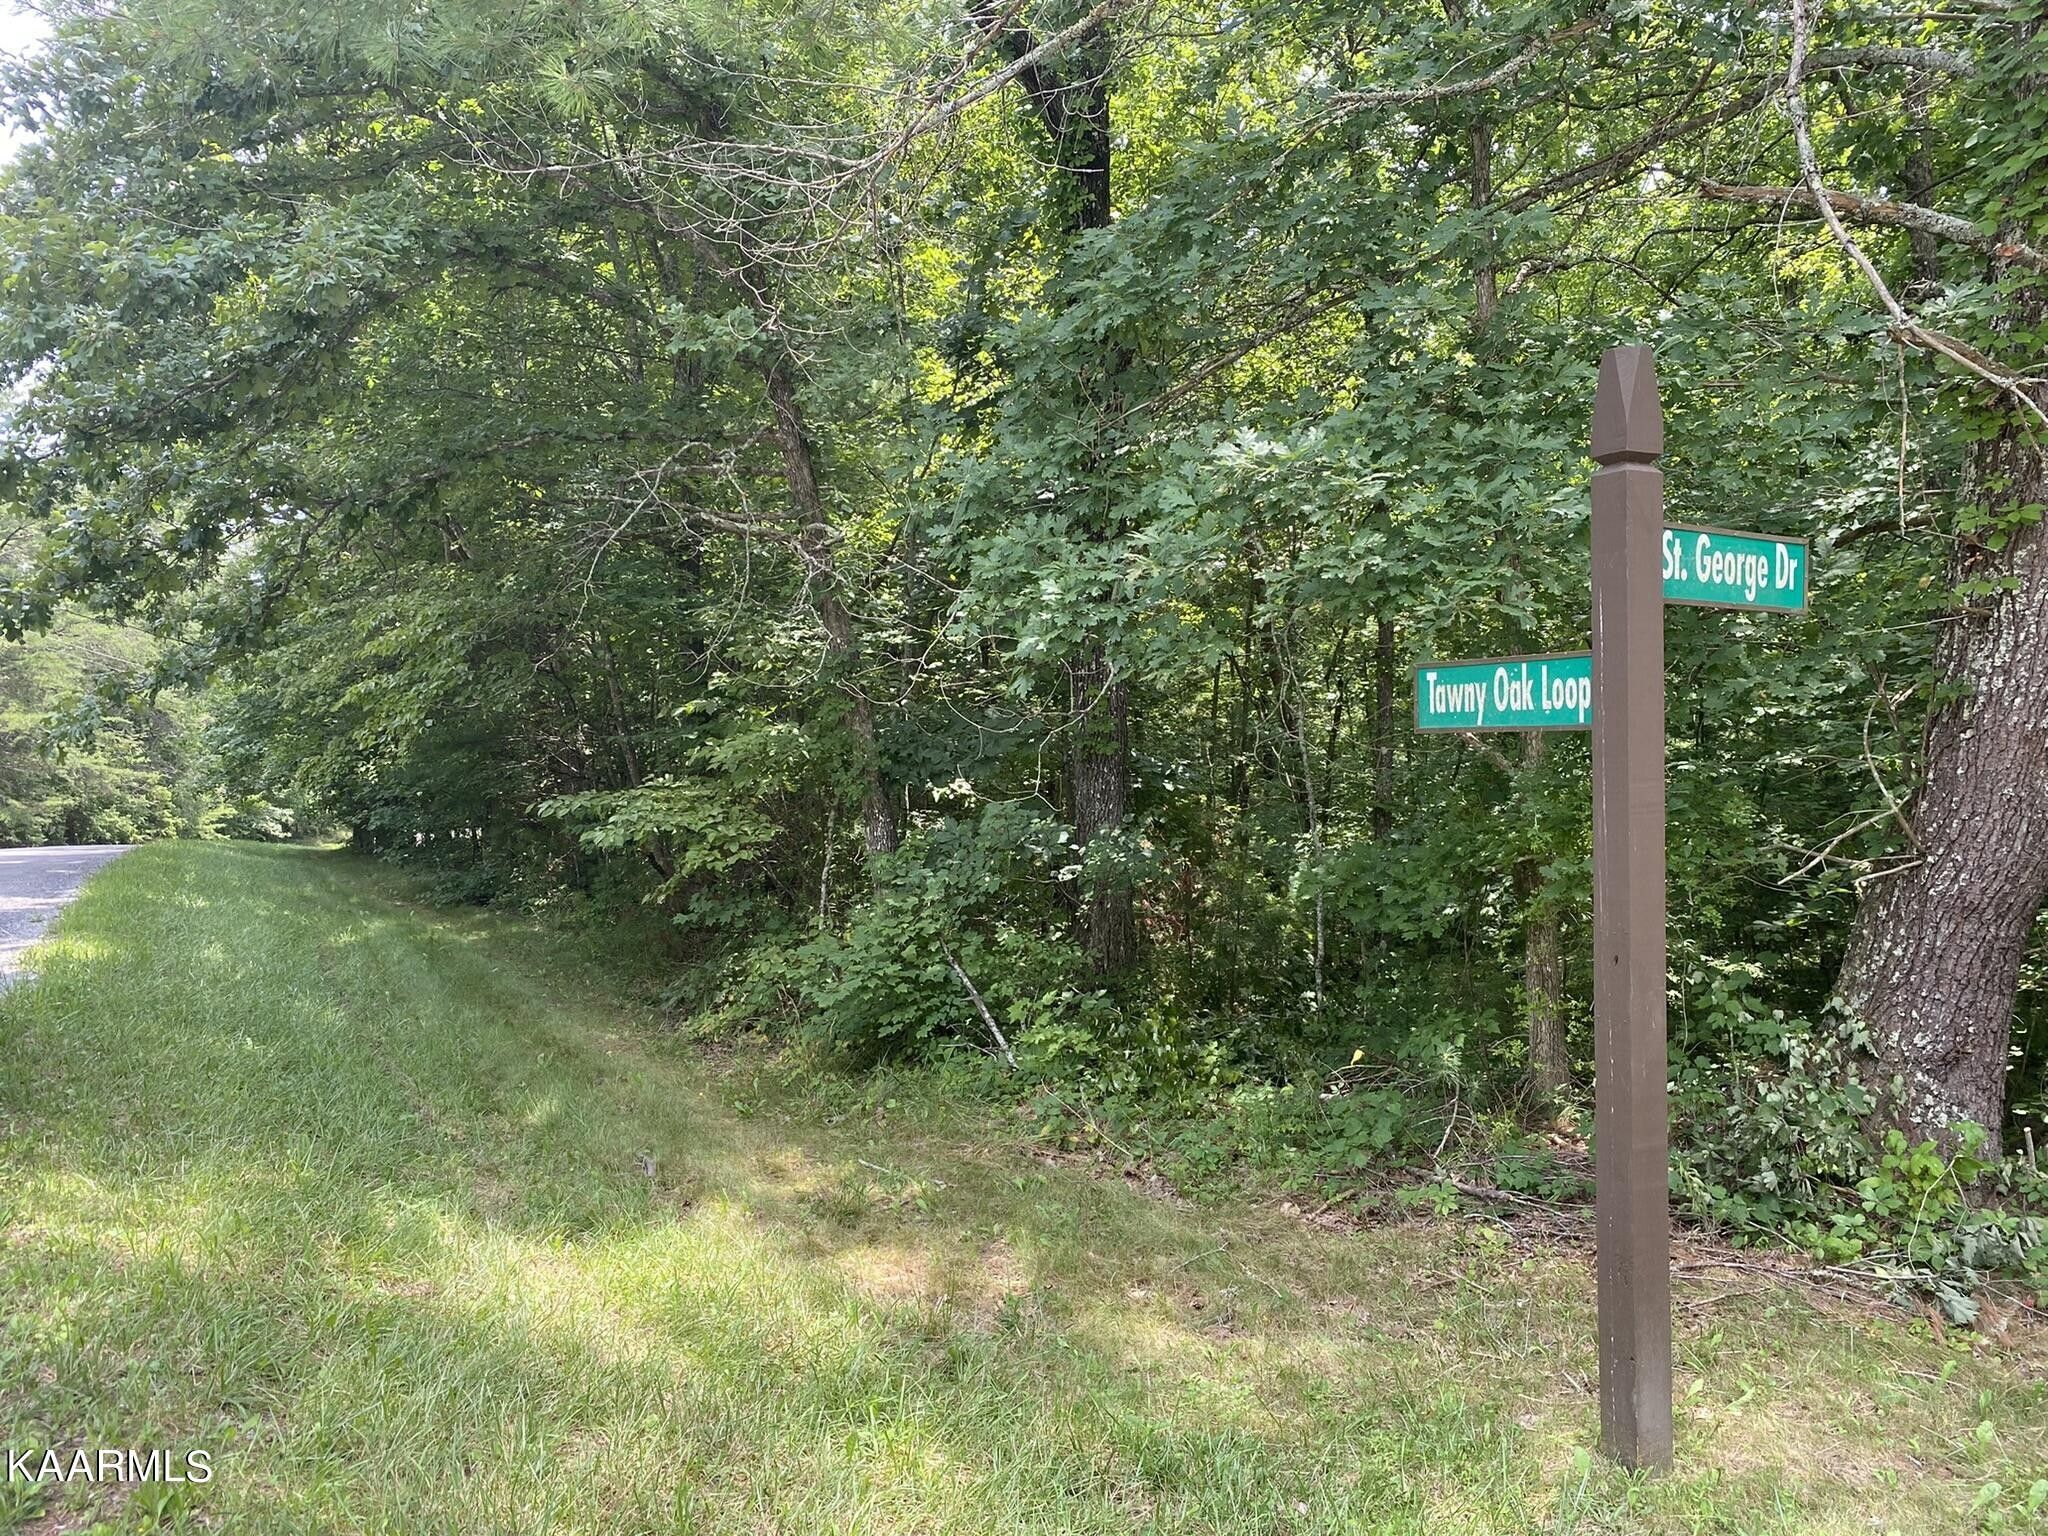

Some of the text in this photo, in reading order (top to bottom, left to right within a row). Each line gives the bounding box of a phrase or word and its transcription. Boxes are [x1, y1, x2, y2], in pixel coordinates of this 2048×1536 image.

[1662, 529, 1798, 601] St. George Dr
[1426, 663, 1591, 726] Tawny Oak Loop
